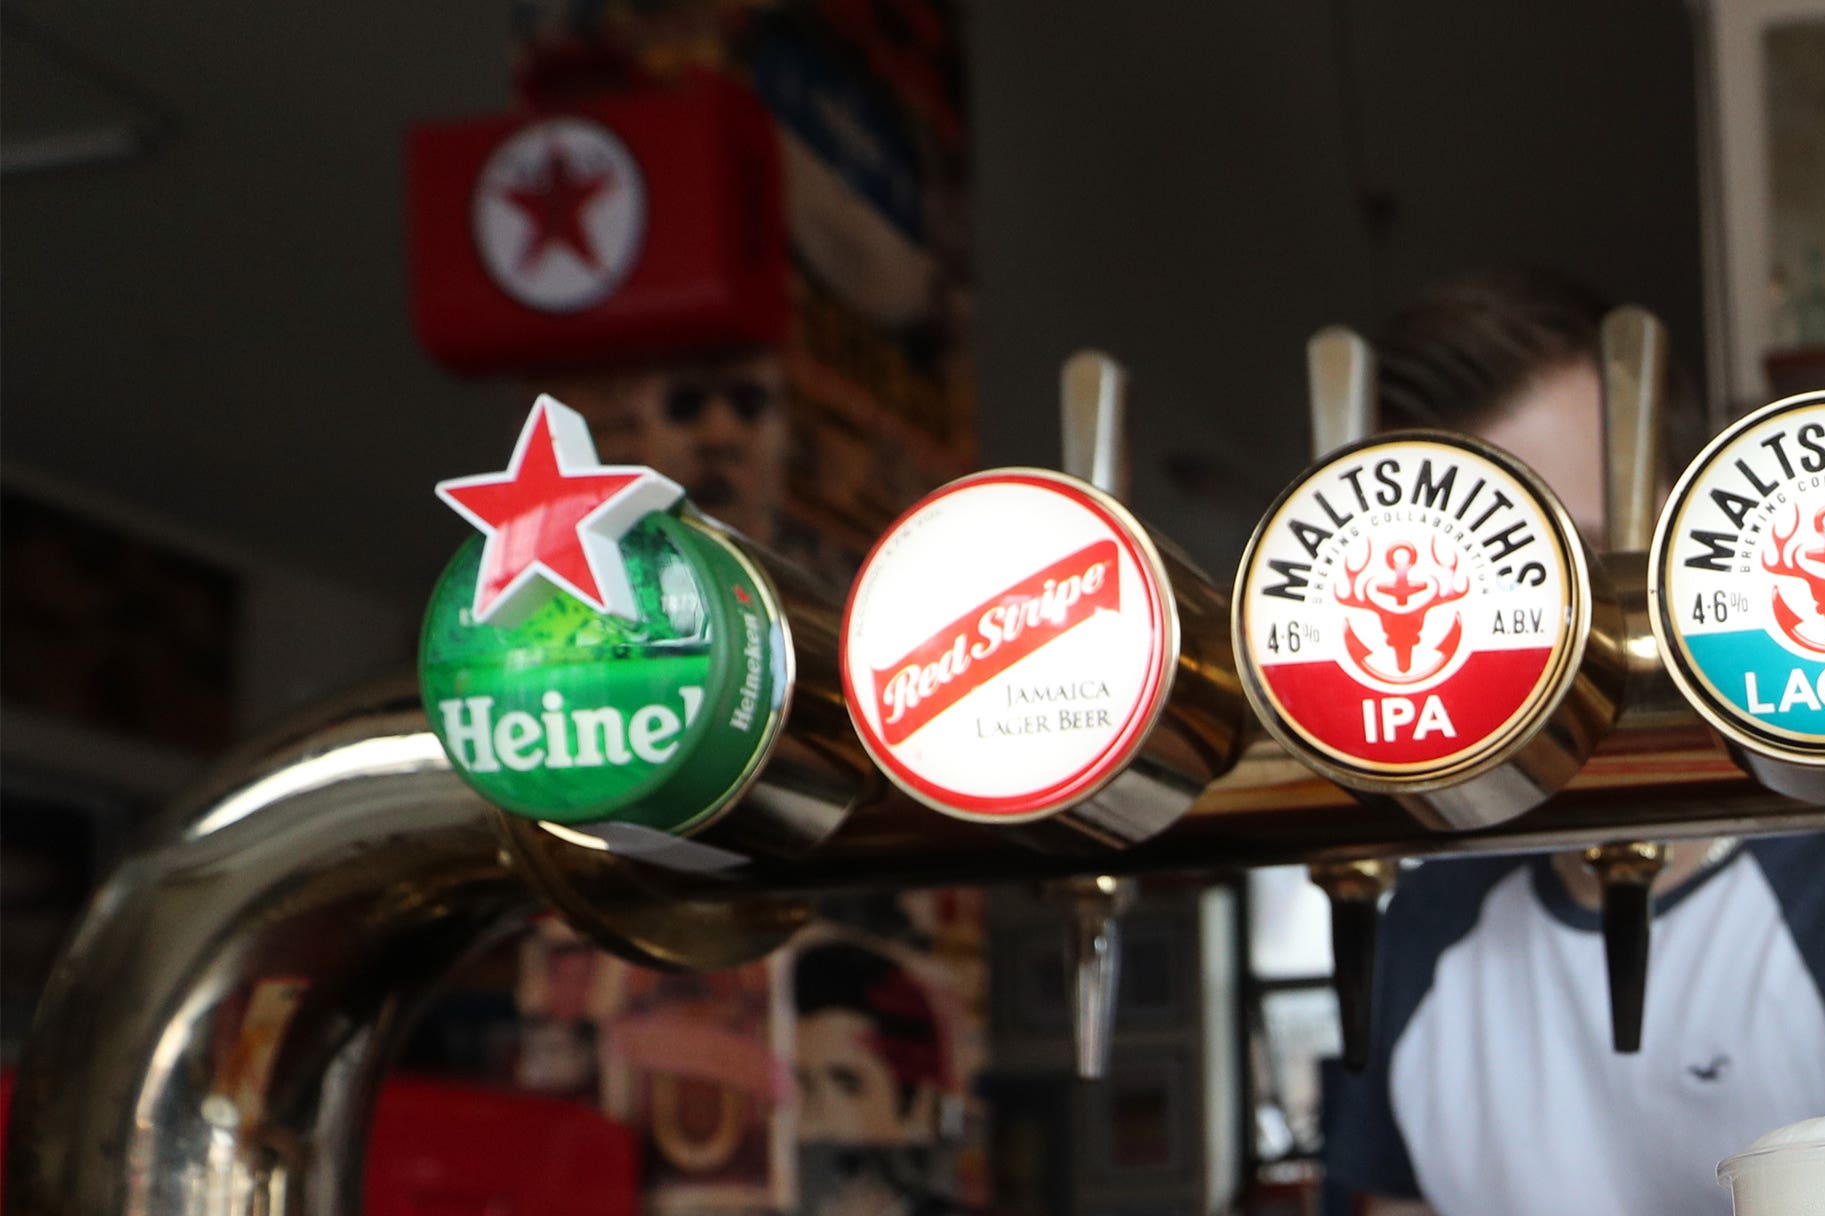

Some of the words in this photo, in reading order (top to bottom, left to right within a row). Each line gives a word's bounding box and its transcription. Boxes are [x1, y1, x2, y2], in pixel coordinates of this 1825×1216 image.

[1262, 459, 1547, 602] MALTSMITHS
[1740, 493, 1786, 574] BREWING
[883, 633, 970, 724] Red
[970, 562, 1107, 659] Stripe
[1492, 608, 1544, 635] A.B.V.
[730, 612, 763, 731] Heineken
[1005, 680, 1111, 707] JAMAICA
[977, 714, 1050, 738] LAGER
[1059, 709, 1112, 731] BEER
[1362, 695, 1457, 744] IPA
